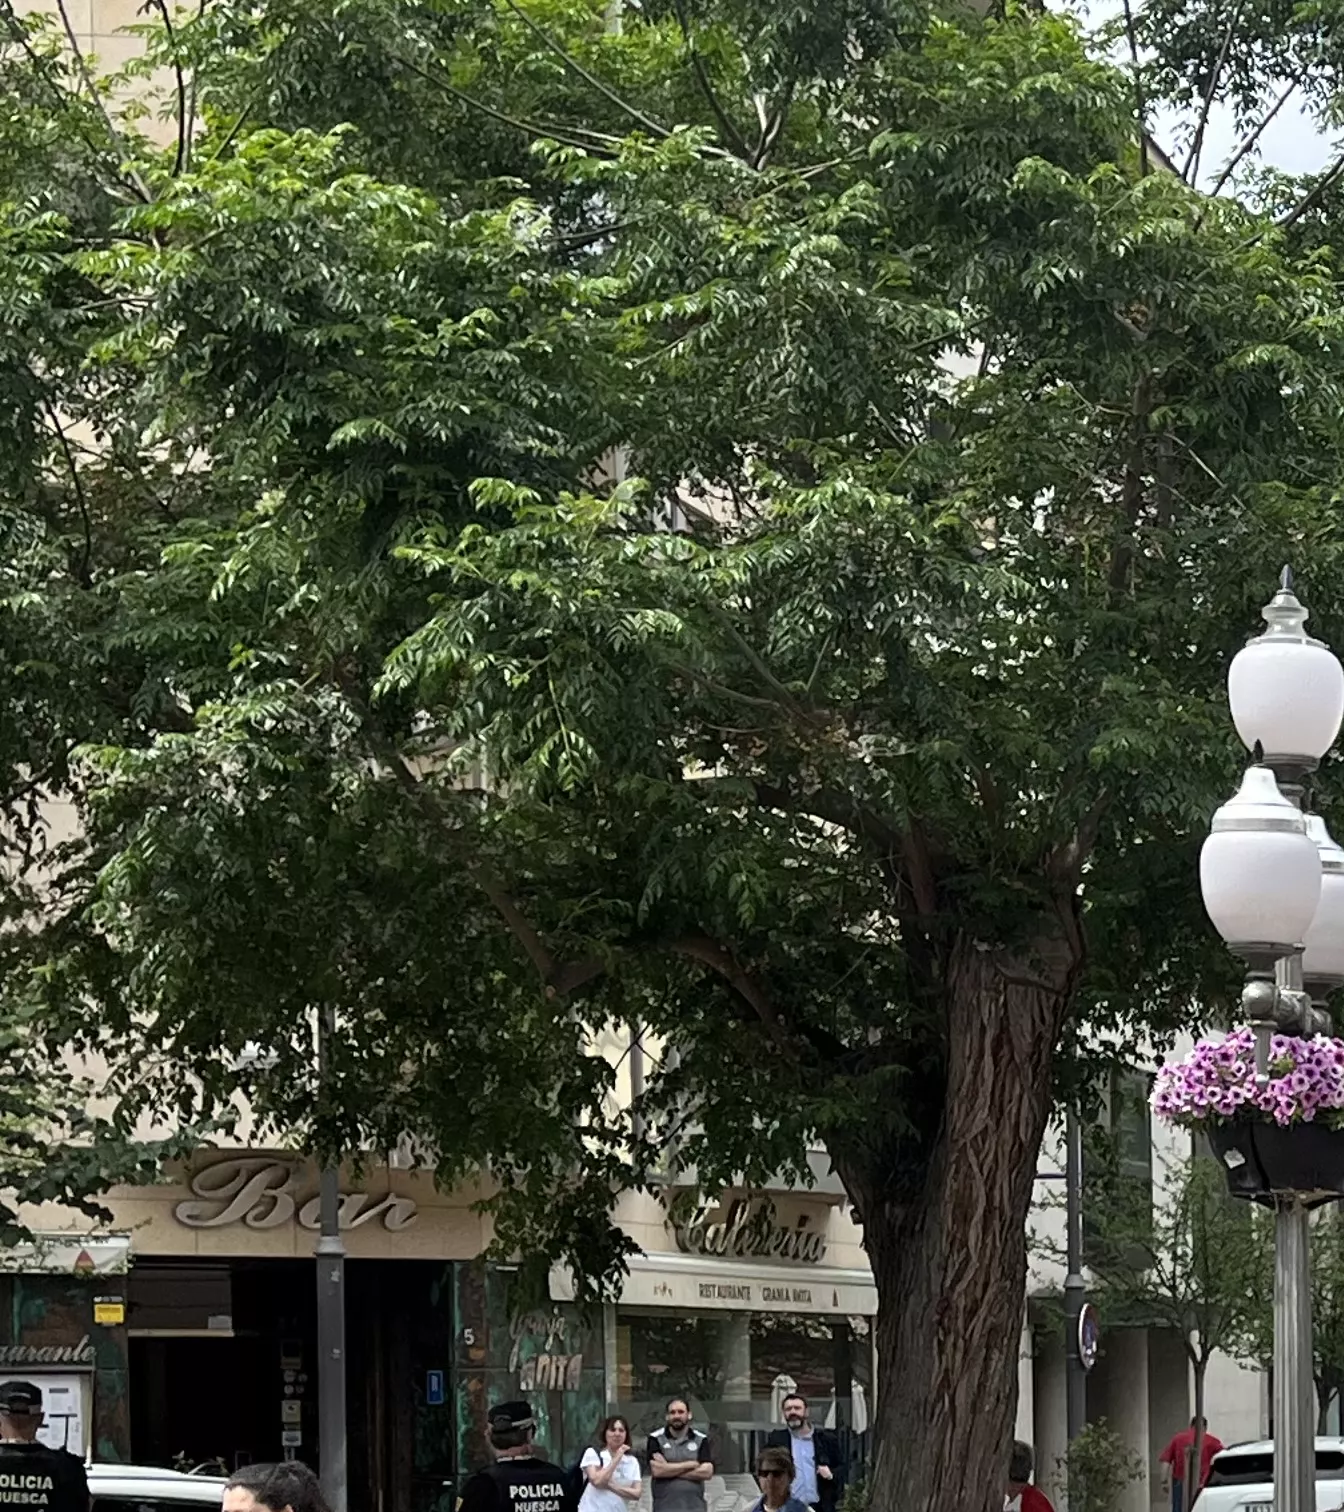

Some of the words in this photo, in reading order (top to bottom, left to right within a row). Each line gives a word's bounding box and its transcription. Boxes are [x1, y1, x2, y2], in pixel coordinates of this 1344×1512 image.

[175, 1156, 417, 1231] Bar
[463, 1327, 475, 1346] 5
[0, 1474, 53, 1490] OLICIA
[0, 1491, 49, 1505] UESCA
[509, 1483, 564, 1499] POLICIA
[514, 1500, 560, 1512] HUESCA
